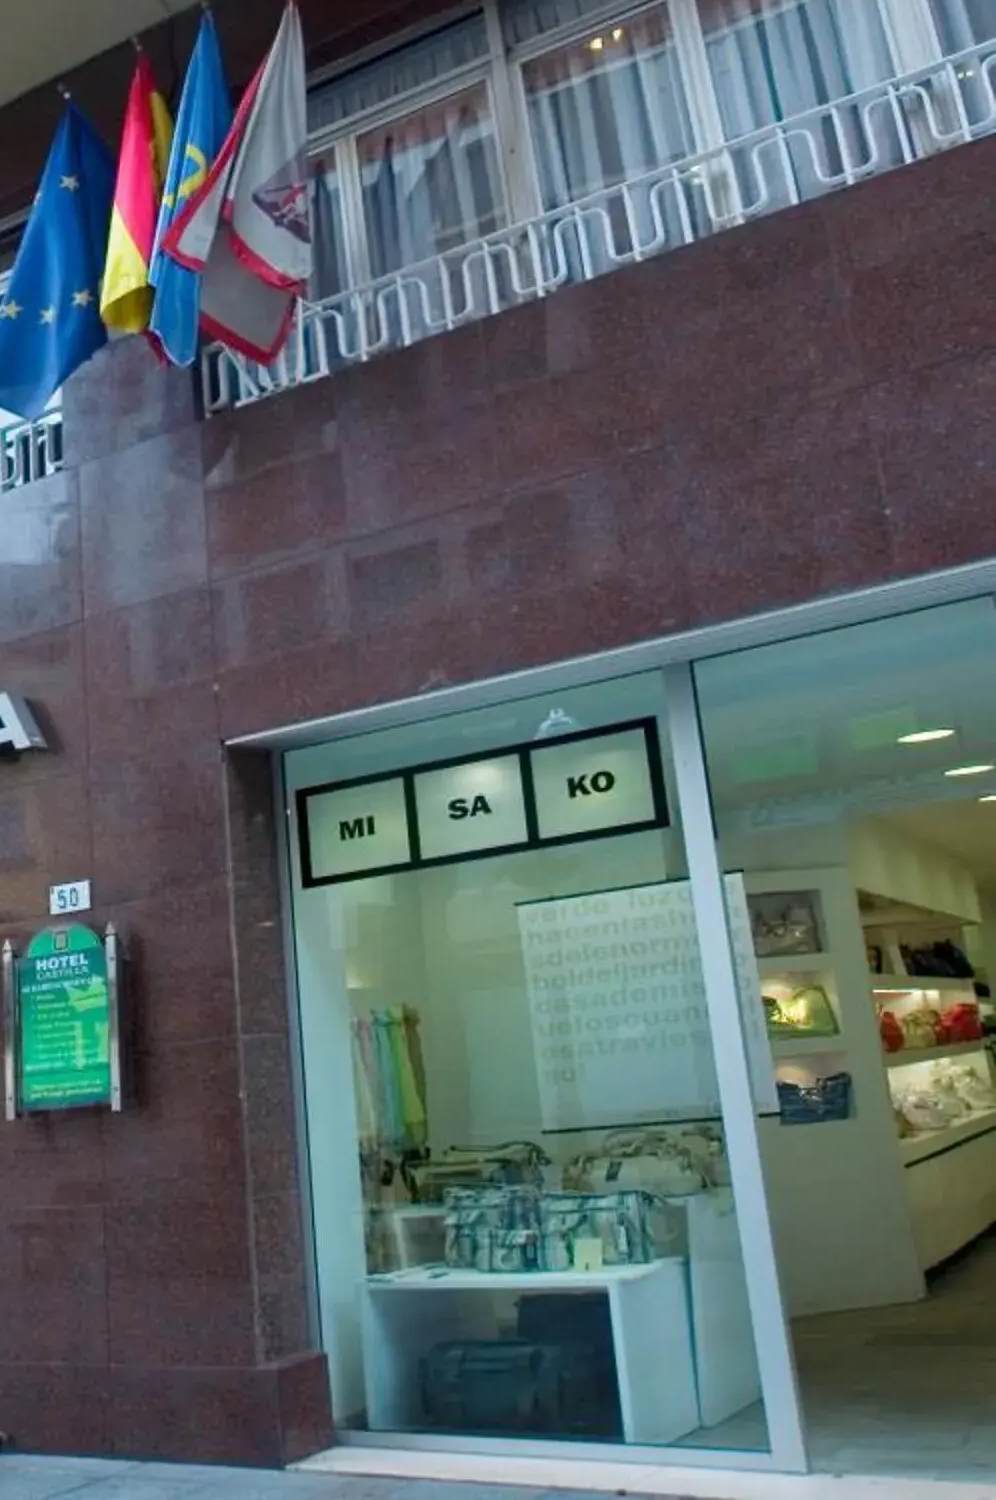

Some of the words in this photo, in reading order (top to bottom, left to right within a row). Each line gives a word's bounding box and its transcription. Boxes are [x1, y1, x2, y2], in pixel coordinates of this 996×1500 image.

[339, 815, 376, 842] MI
[447, 795, 492, 821] SA
[566, 770, 615, 799] KO
[57, 887, 79, 909] 50
[35, 953, 88, 971] HOTEL
